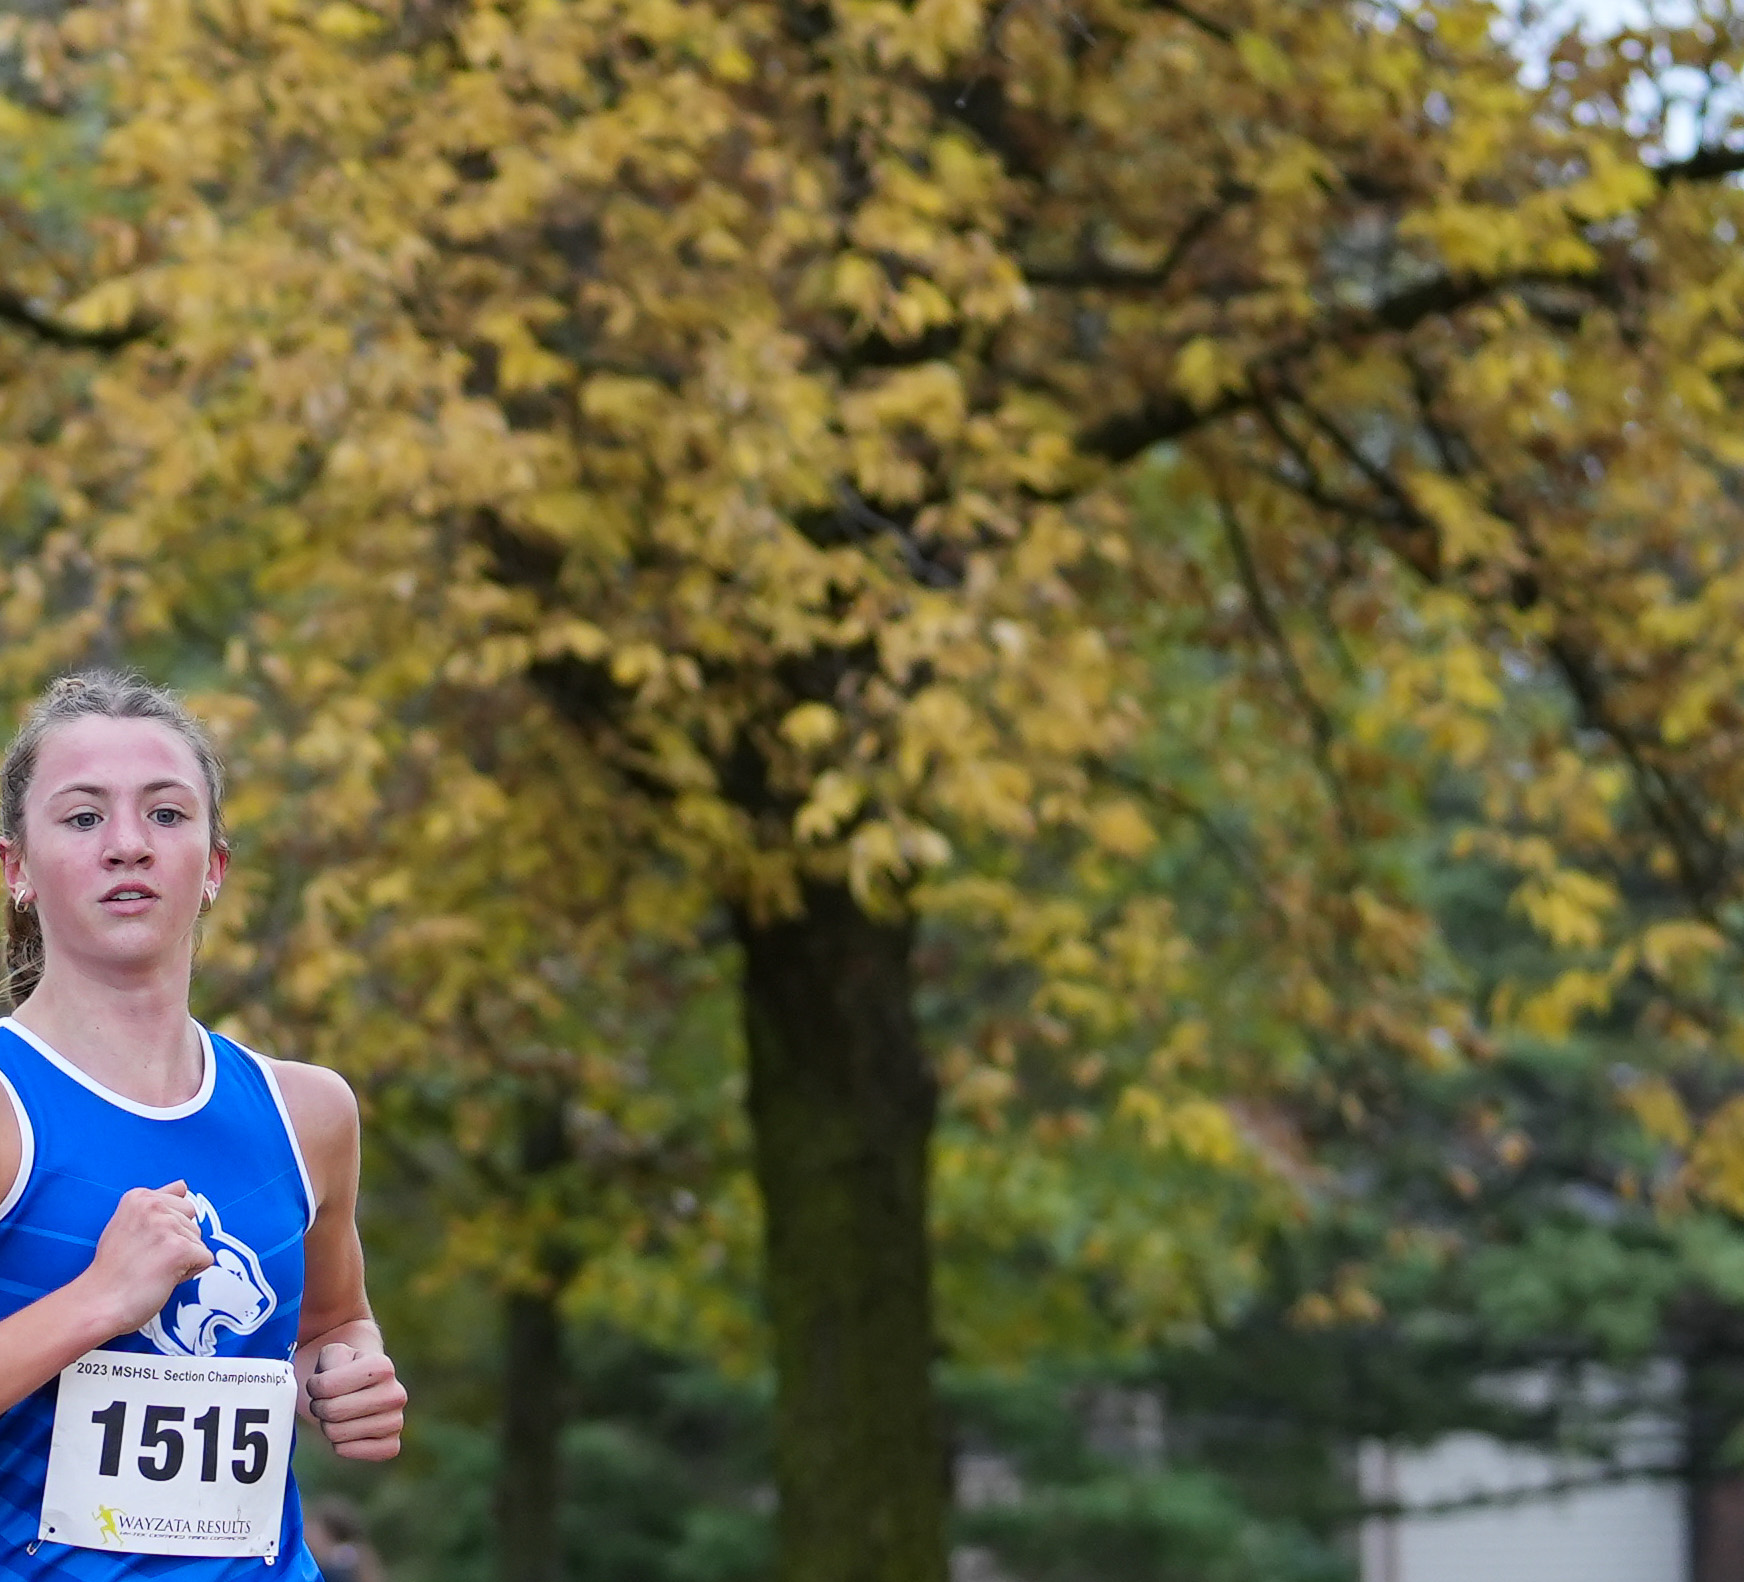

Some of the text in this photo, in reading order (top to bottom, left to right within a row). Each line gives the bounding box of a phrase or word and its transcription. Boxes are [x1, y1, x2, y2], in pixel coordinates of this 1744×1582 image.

[77, 1362, 287, 1386] 2023 MSHSL Section Championships
[91, 1400, 270, 1484] 1515
[119, 1515, 252, 1534] WAYZATA RESULTS
